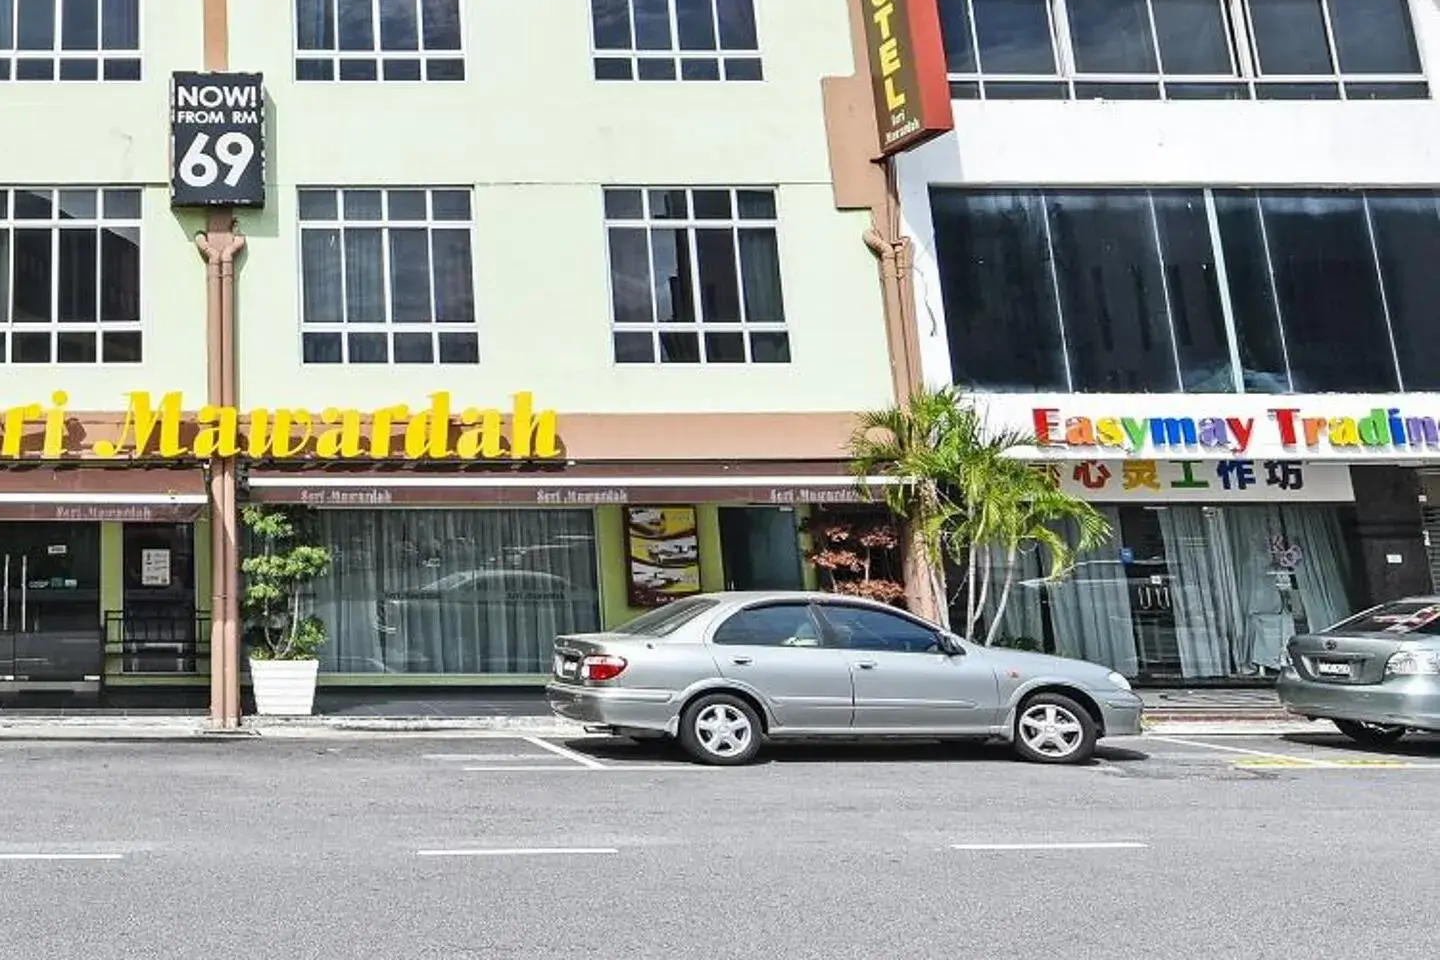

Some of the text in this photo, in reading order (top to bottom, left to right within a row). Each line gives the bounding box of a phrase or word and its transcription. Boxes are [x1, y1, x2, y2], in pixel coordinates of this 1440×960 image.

[177, 85, 257, 108] NOW!
[177, 110, 258, 124] FROM RM
[178, 131, 255, 187] 69
[93, 390, 563, 460] Mawardah
[1032, 407, 1440, 454] Easymay Tradin
